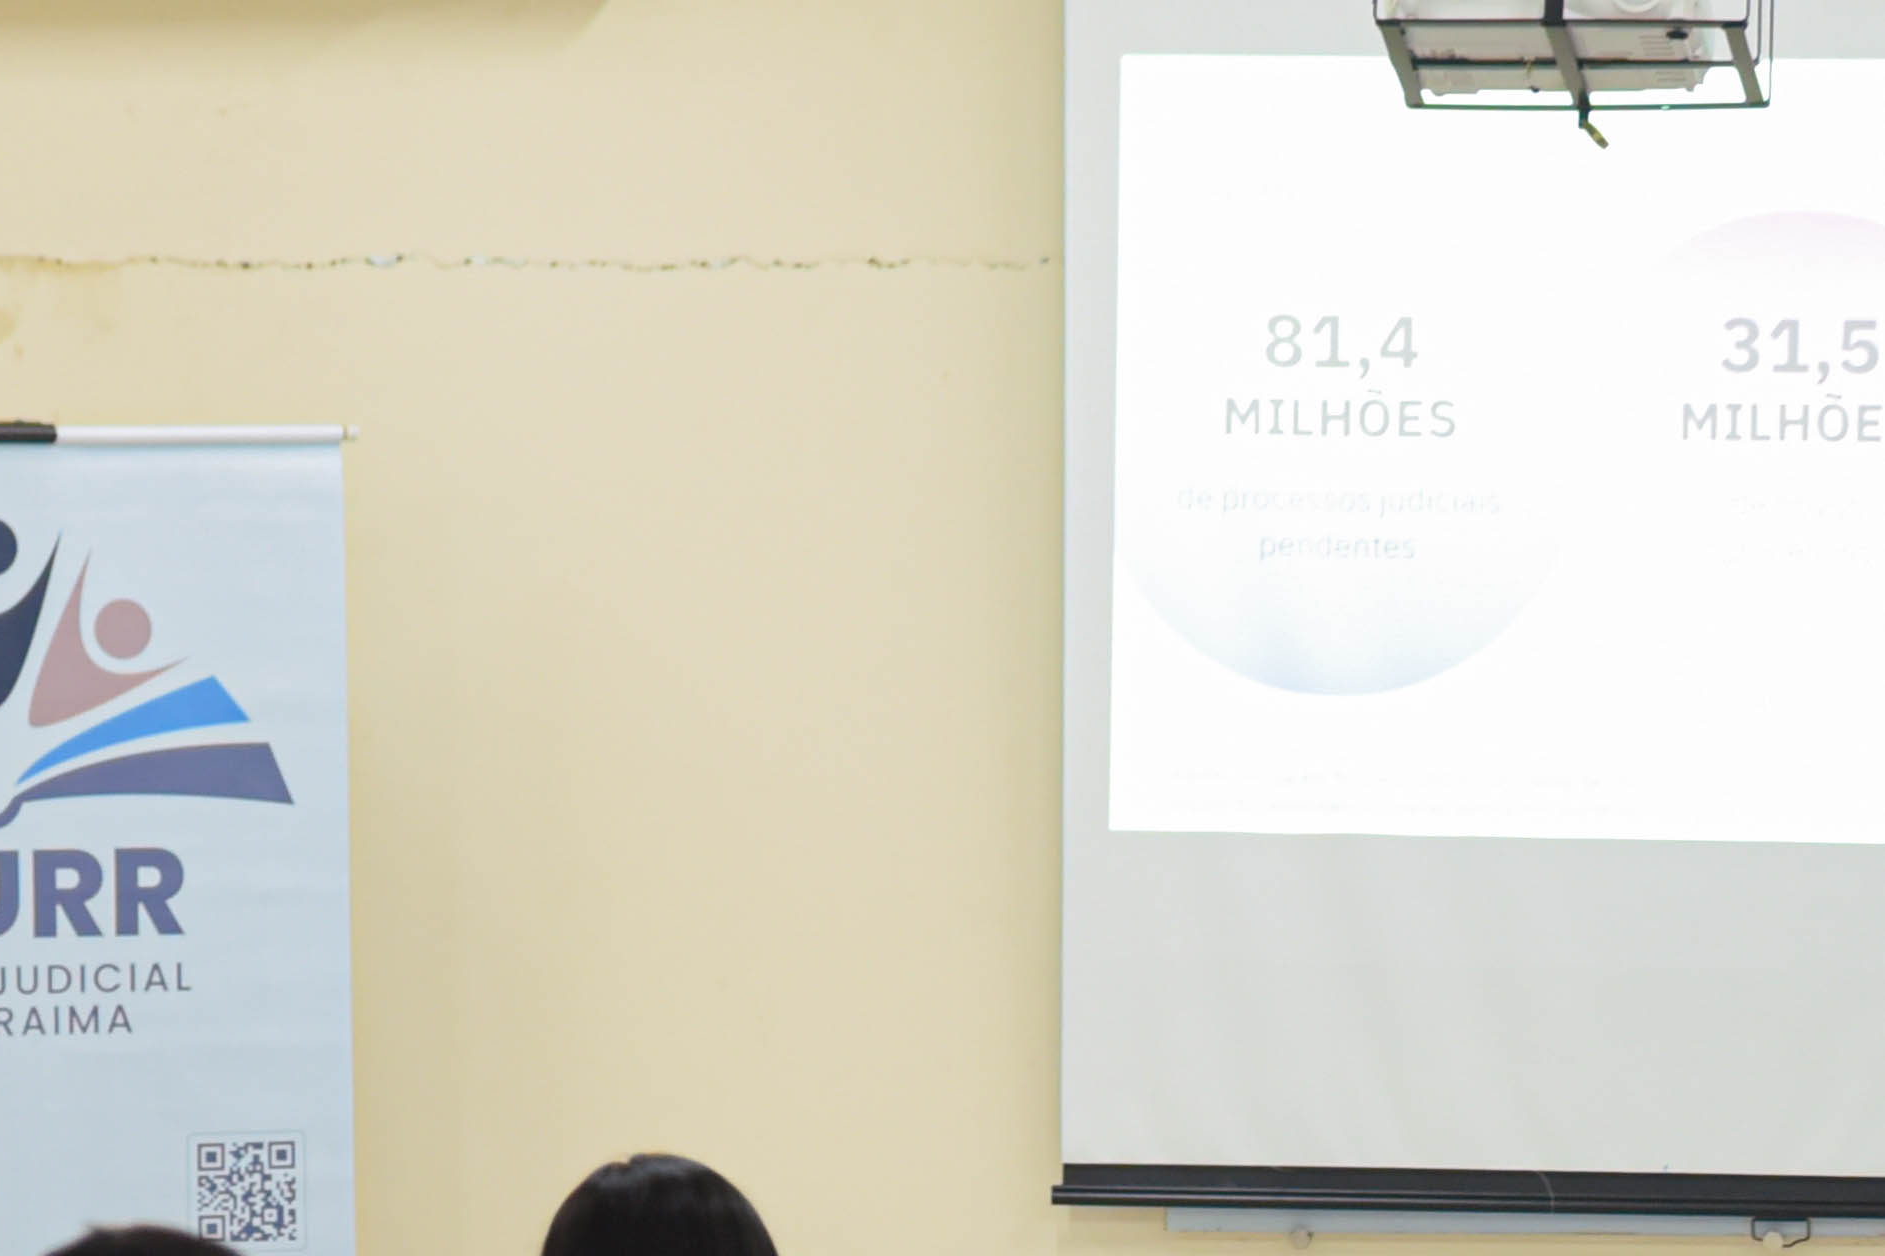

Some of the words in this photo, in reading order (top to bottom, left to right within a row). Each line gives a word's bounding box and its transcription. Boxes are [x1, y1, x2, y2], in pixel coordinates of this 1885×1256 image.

[1265, 314, 1419, 379] 81,4
[1721, 317, 1880, 384] 31,5
[1225, 388, 1456, 439] MILHÕES
[1177, 487, 1213, 510] de
[1258, 534, 1416, 564] pendentes
